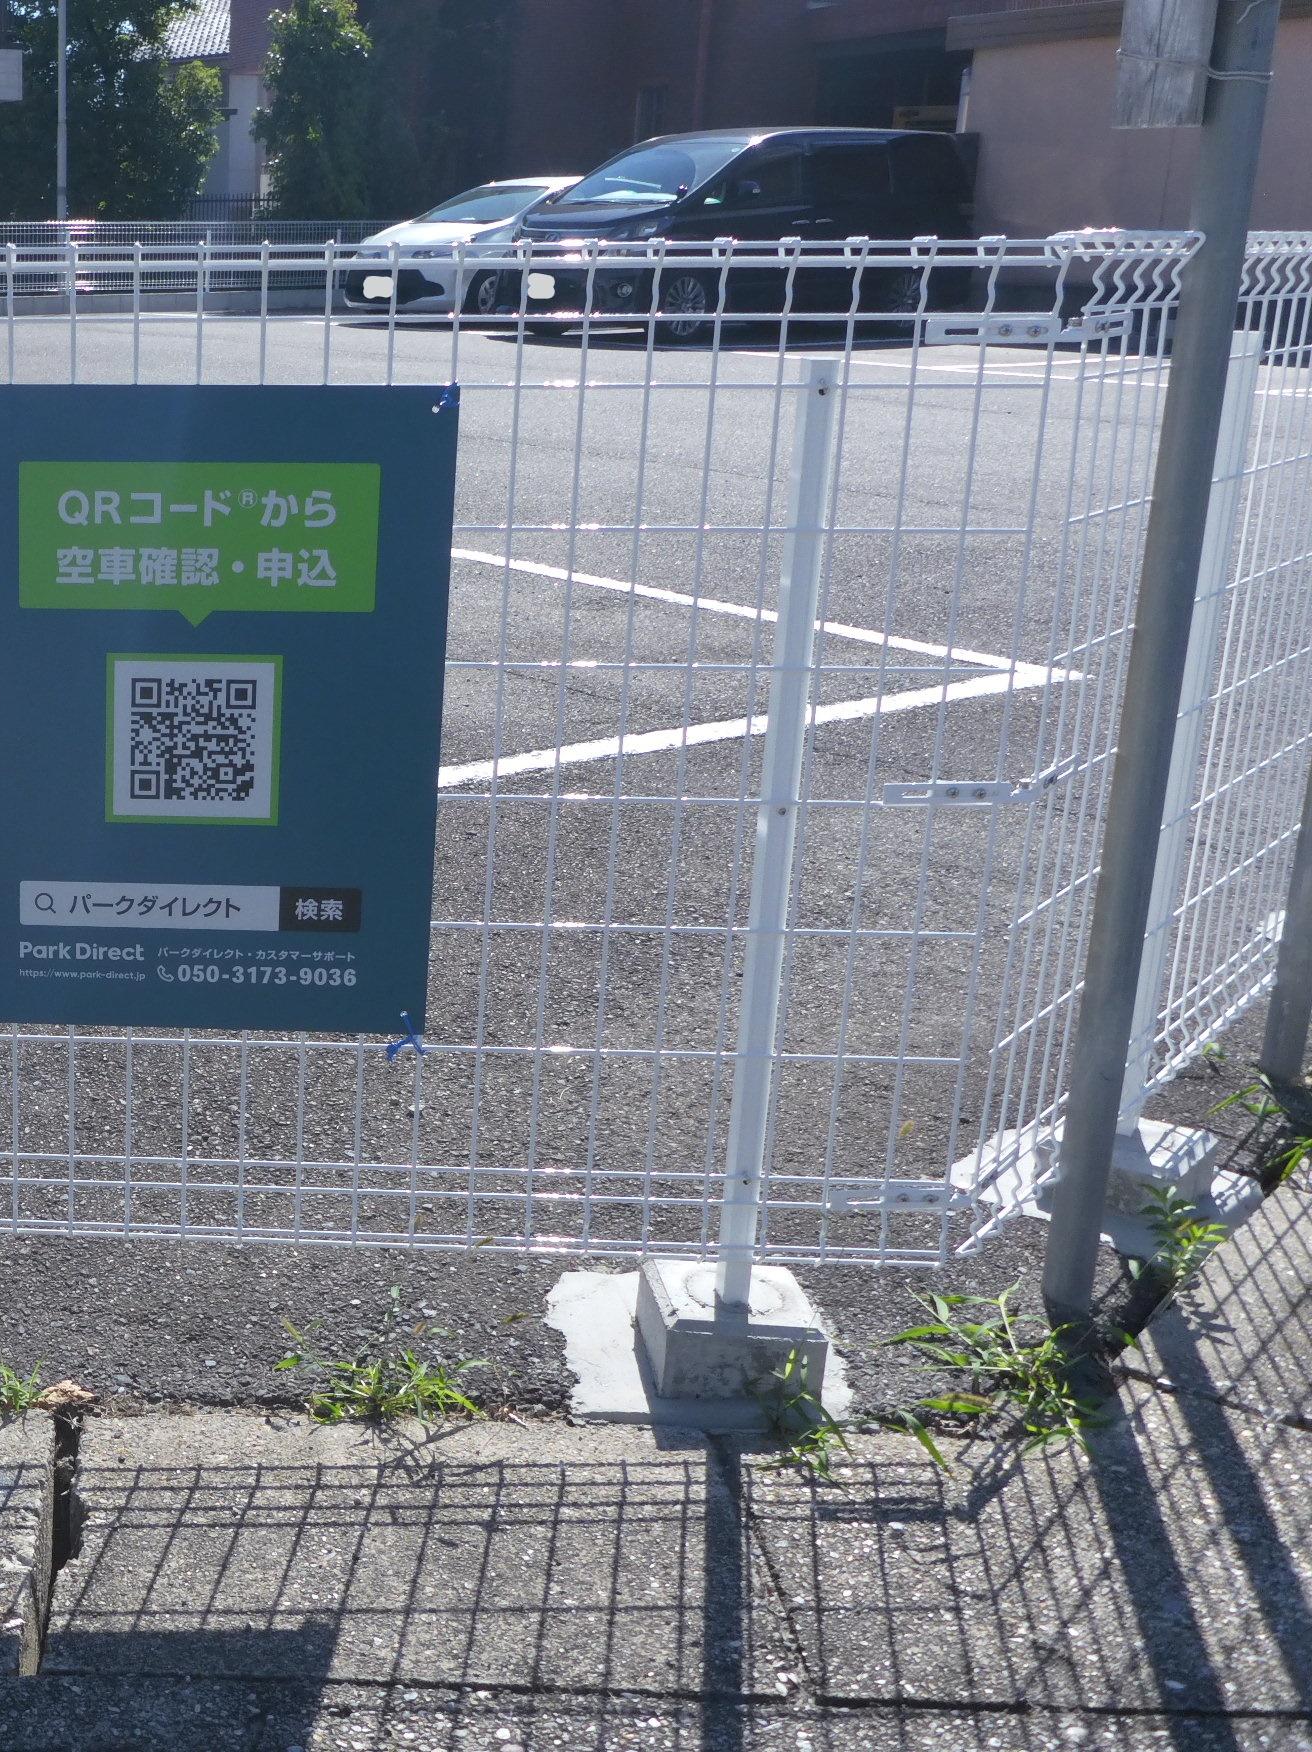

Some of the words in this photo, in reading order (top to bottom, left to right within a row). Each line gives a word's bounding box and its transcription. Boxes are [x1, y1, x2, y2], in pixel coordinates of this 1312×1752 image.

[55, 547, 338, 588] 空車確認・申込
[69, 893, 241, 919] パークダイレクト
[295, 898, 344, 921] 検索
[19, 941, 71, 961] Park
[75, 942, 145, 962] Direct
[157, 947, 356, 962] パークダイレクト・カスタマーサポート
[19, 968, 146, 981] https://www.park-direct.jp
[177, 964, 357, 987] 050-3173-9036
